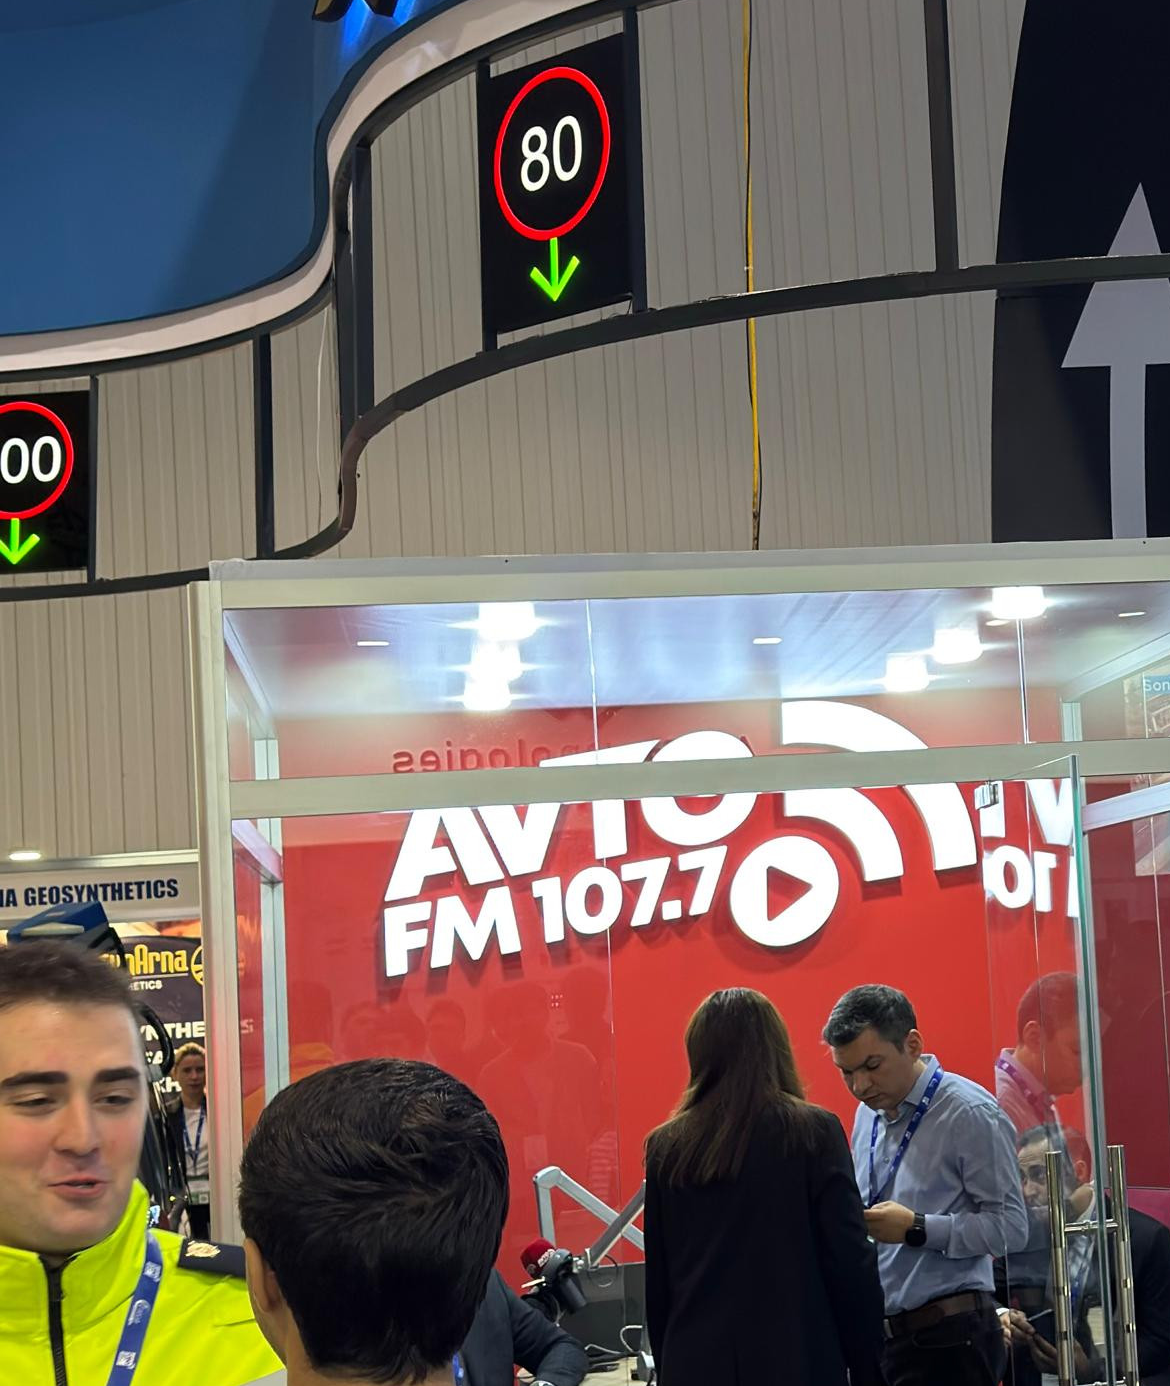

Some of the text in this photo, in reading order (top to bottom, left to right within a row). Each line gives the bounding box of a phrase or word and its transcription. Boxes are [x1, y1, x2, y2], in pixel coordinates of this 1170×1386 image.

[520, 115, 583, 192] 80
[0, 436, 62, 484] 00
[24, 879, 179, 906] GEOSYNTHETICS
[384, 845, 728, 977] FM 107.7
